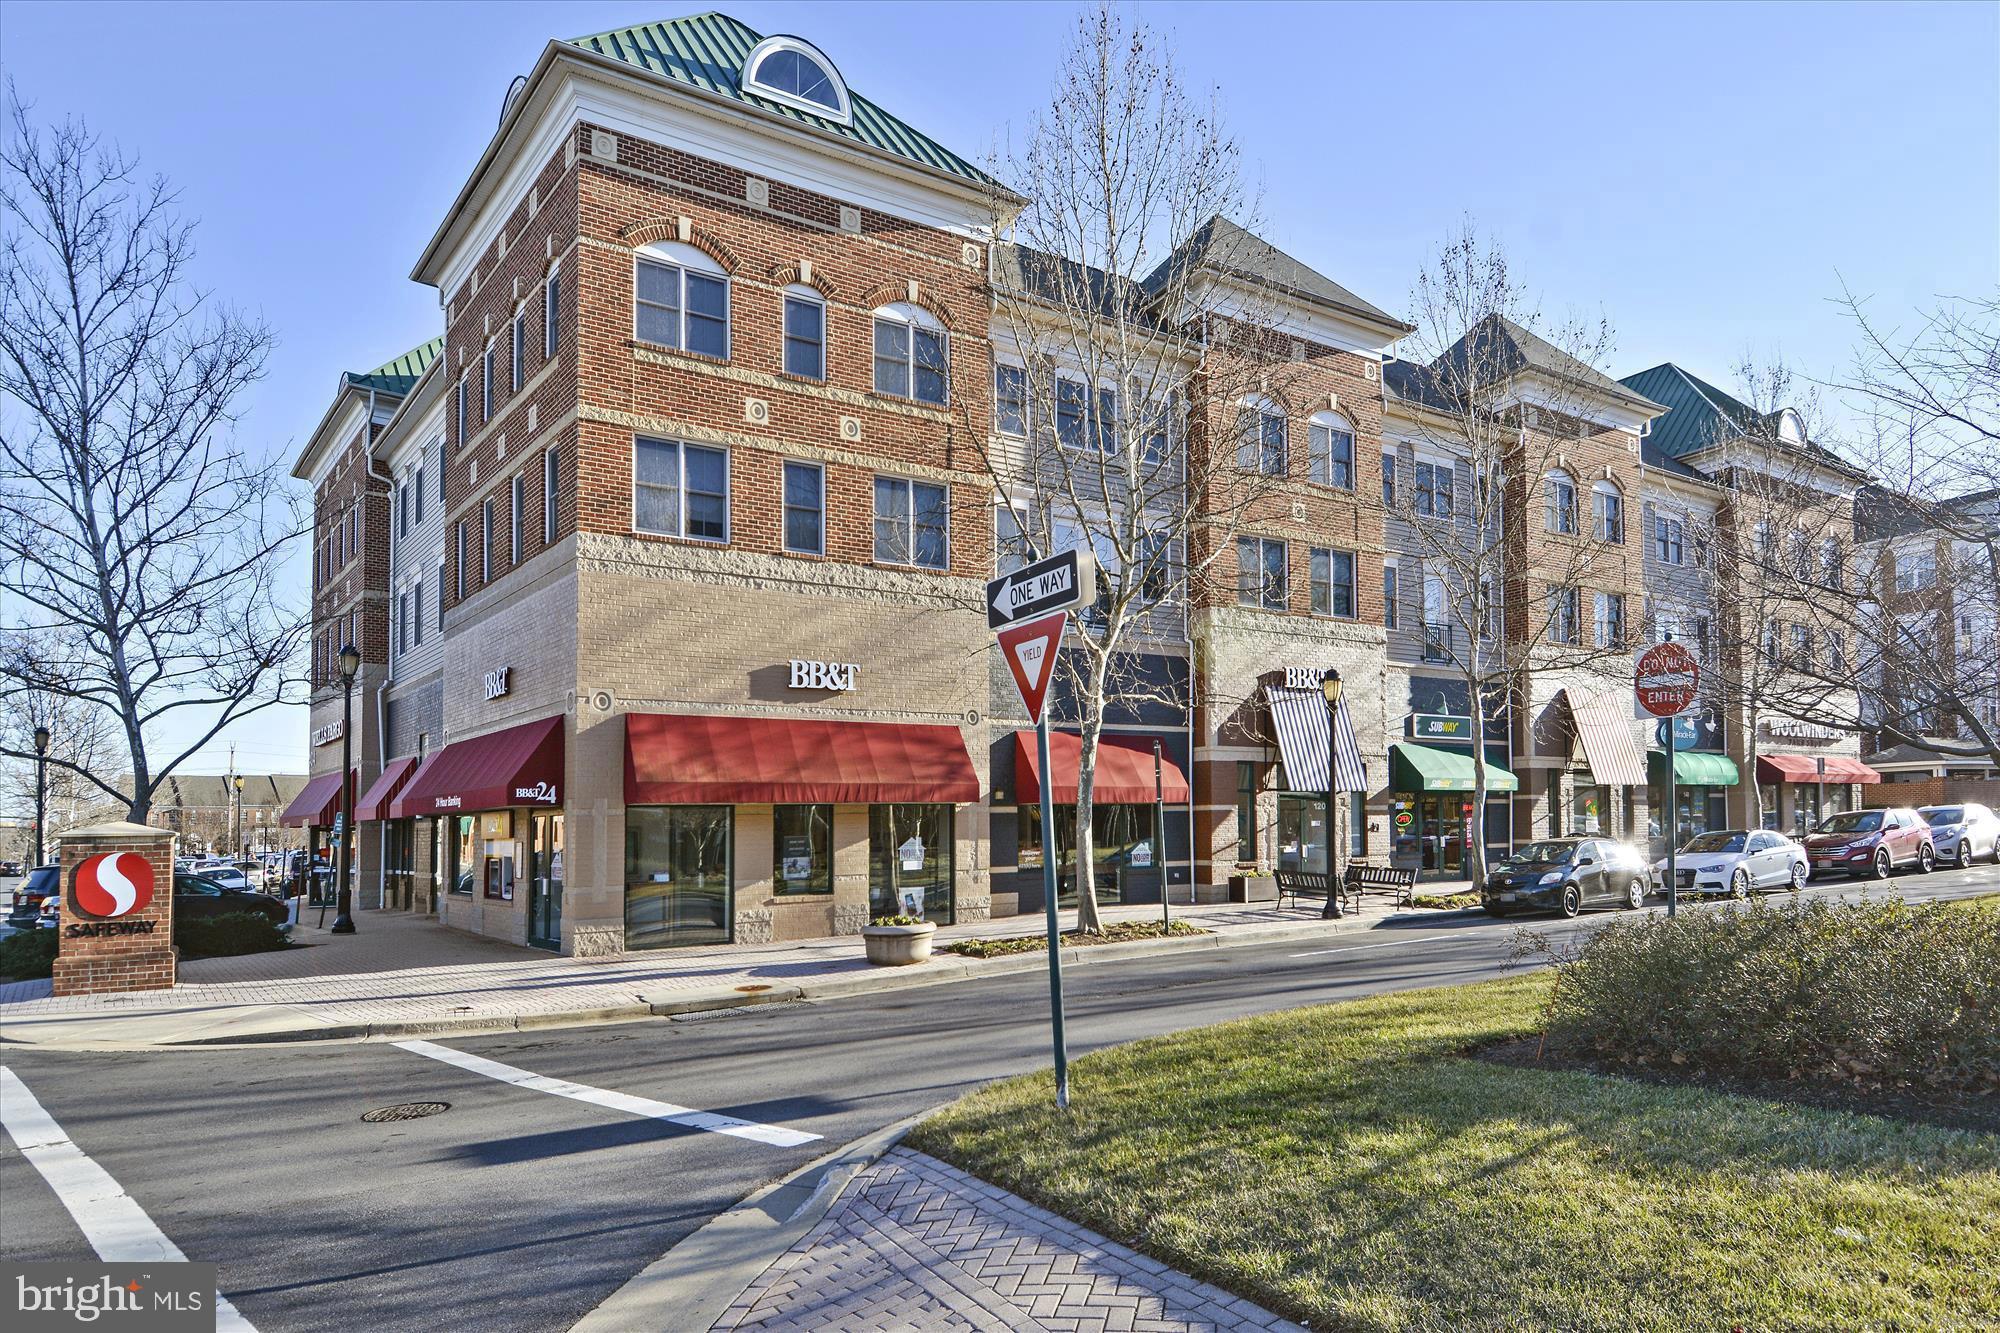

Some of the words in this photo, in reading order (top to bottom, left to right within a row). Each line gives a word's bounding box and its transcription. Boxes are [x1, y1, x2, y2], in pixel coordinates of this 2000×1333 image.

[1010, 581, 1034, 606] ONE
[1040, 568, 1066, 595] WAY
[1022, 646, 1042, 662] YIELD
[1643, 658, 1659, 671] DO
[788, 659, 862, 691] BB&T
[484, 666, 508, 700] BB&T
[1648, 691, 1684, 704] ENTER
[1428, 721, 1459, 733] SUBWAY
[1430, 779, 1453, 788] SUBWAY
[1462, 780, 1476, 788] SUBW
[1314, 802, 1326, 810] 120
[1397, 815, 1411, 823] OPEN
[65, 920, 159, 938] SAFEWAY
